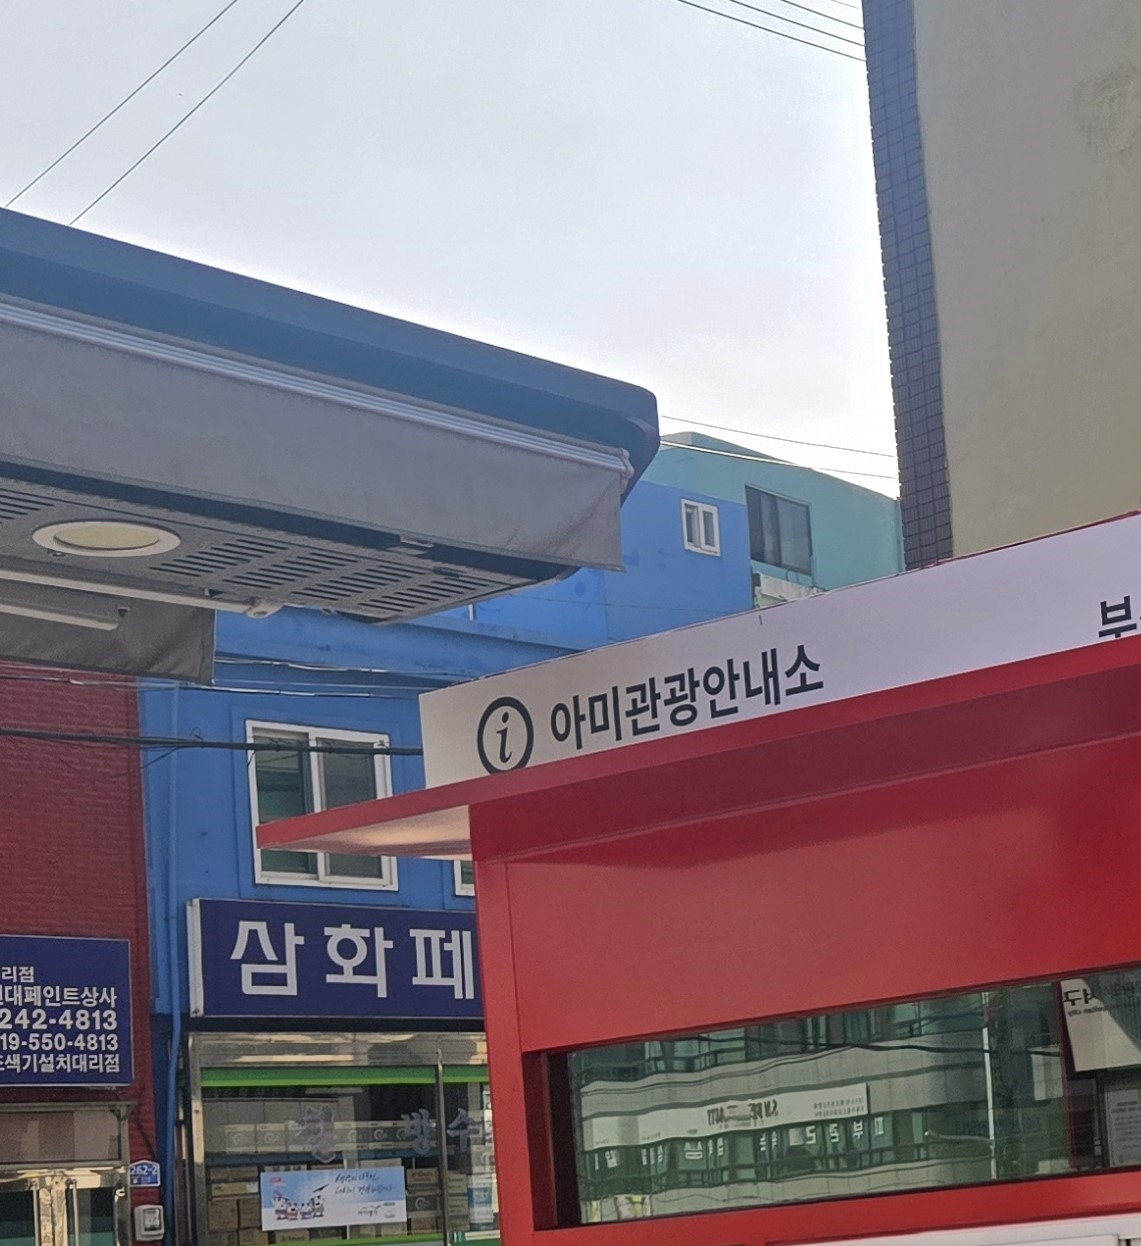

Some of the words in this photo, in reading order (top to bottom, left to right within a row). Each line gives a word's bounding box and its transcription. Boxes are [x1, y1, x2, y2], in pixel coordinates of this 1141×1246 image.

[550, 645, 824, 750] 아미관광안내소
[230, 920, 475, 1000] 삼화페
[1, 965, 35, 983] 리점
[0, 984, 118, 1009] 대페인트상사
[0, 1008, 118, 1031] 242-4813
[0, 1032, 119, 1052] 19-550-4813
[131, 1164, 158, 1176] 262-2
